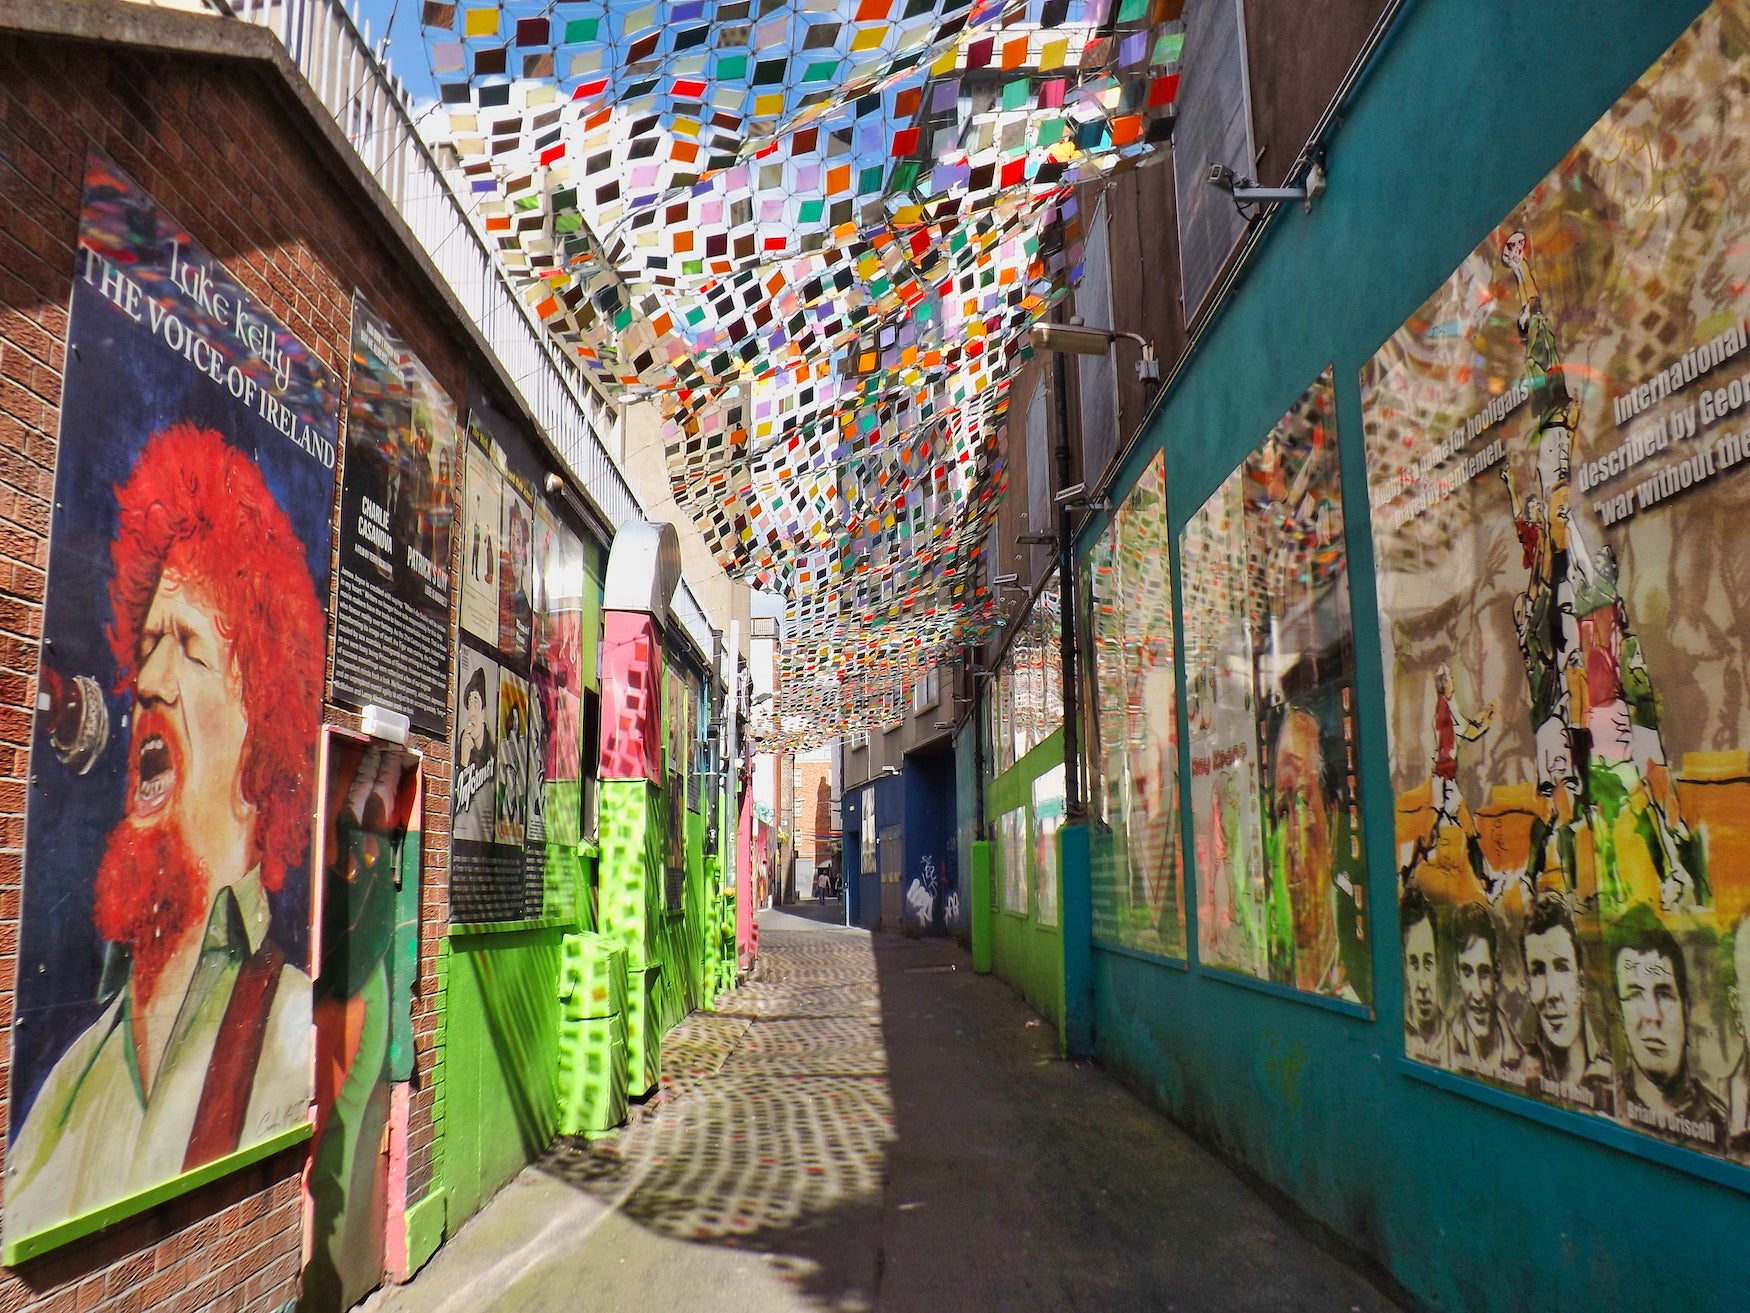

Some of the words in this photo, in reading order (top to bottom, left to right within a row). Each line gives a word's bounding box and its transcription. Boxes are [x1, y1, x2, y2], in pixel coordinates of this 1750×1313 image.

[80, 243, 143, 323] THE
[147, 296, 223, 385] VOICE
[227, 370, 258, 408] OF
[258, 388, 335, 471] IRELAND
[1613, 317, 1748, 425] International
[1450, 424, 1465, 451] for
[1466, 378, 1529, 440] hooligans
[1578, 416, 1668, 493] described
[1669, 404, 1696, 442] by
[1637, 444, 1716, 509] without
[1717, 428, 1750, 469] the
[357, 516, 393, 555] CASANOVA
[361, 495, 390, 531] CHARLIE
